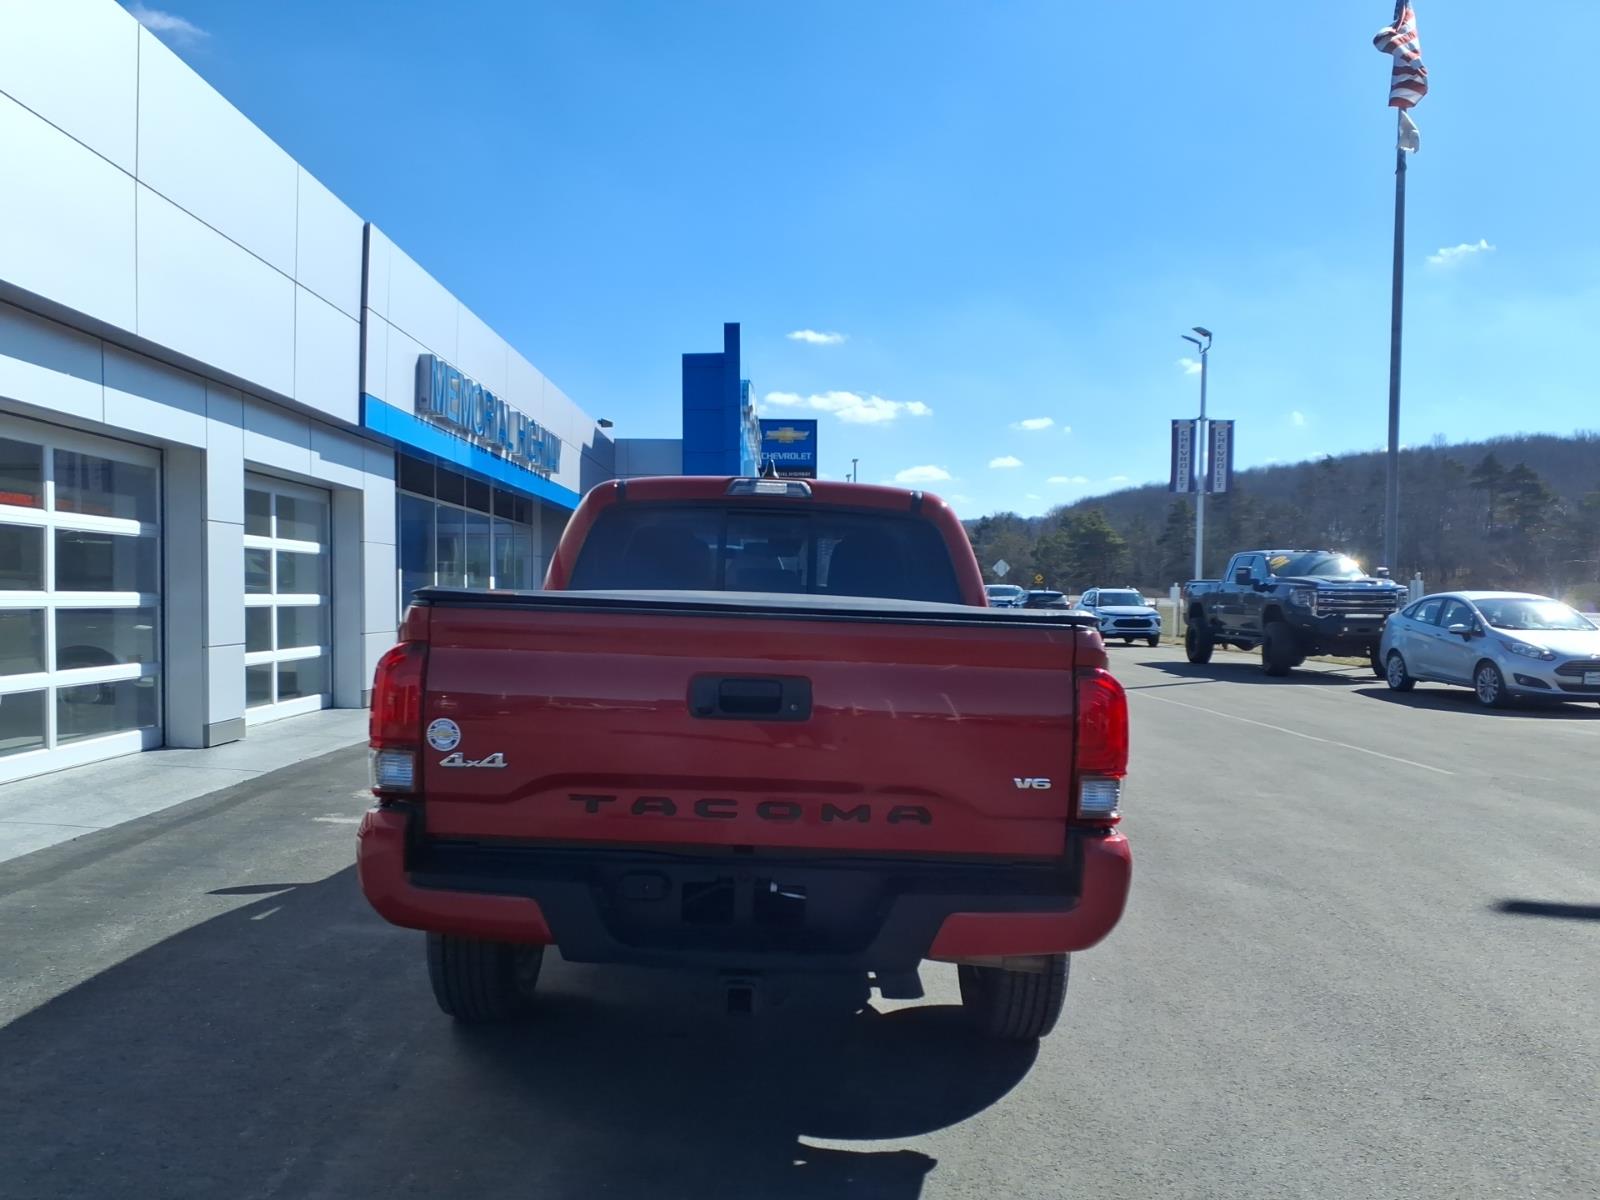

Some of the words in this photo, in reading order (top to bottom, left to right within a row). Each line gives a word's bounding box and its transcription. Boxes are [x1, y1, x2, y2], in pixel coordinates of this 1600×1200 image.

[761, 451, 812, 461] CHEVROLET
[1180, 430, 1188, 489] CHEVROLET
[1216, 431, 1225, 489] CHEVROLET
[439, 752, 508, 768] 4x4
[1013, 777, 1052, 791] V6
[568, 793, 933, 826] TACOMA
